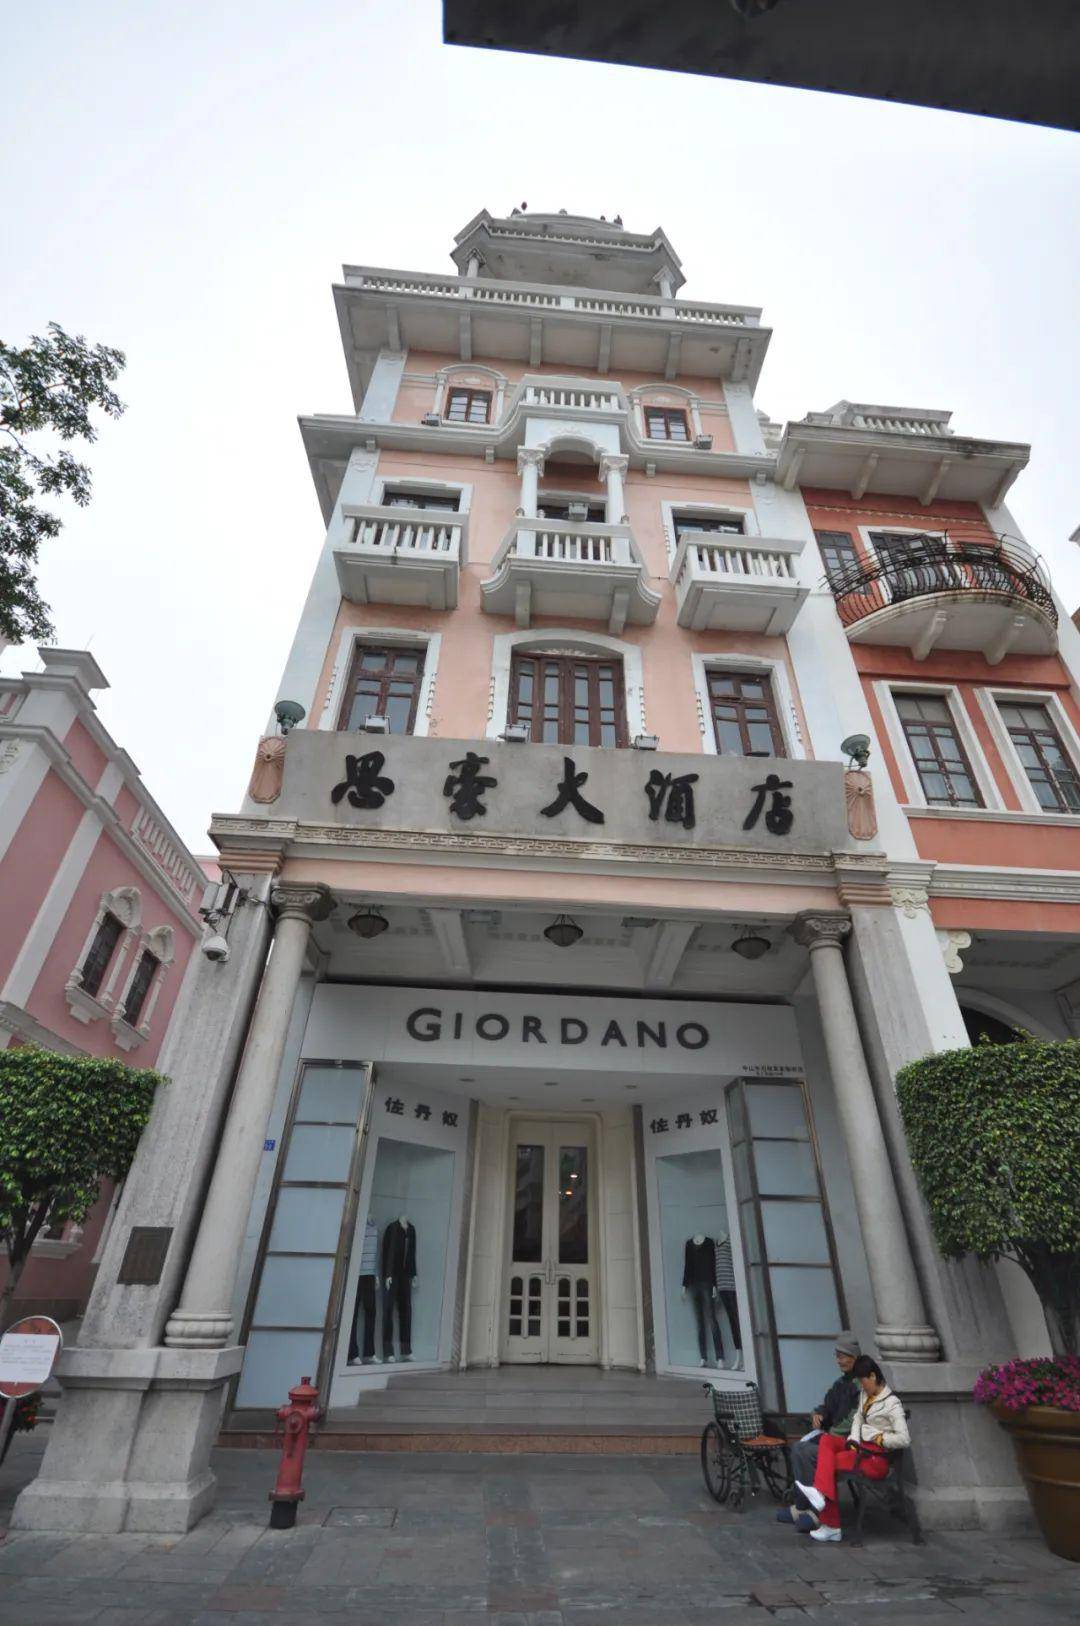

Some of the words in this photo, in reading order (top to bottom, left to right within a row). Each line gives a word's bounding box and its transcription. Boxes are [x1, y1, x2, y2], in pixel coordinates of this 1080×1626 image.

[331, 751, 794, 836] 思豪大酒店
[406, 1007, 710, 1050] GIORDANO
[385, 1097, 459, 1128] 佐丹奴
[650, 1109, 719, 1134] 佐丹奴
